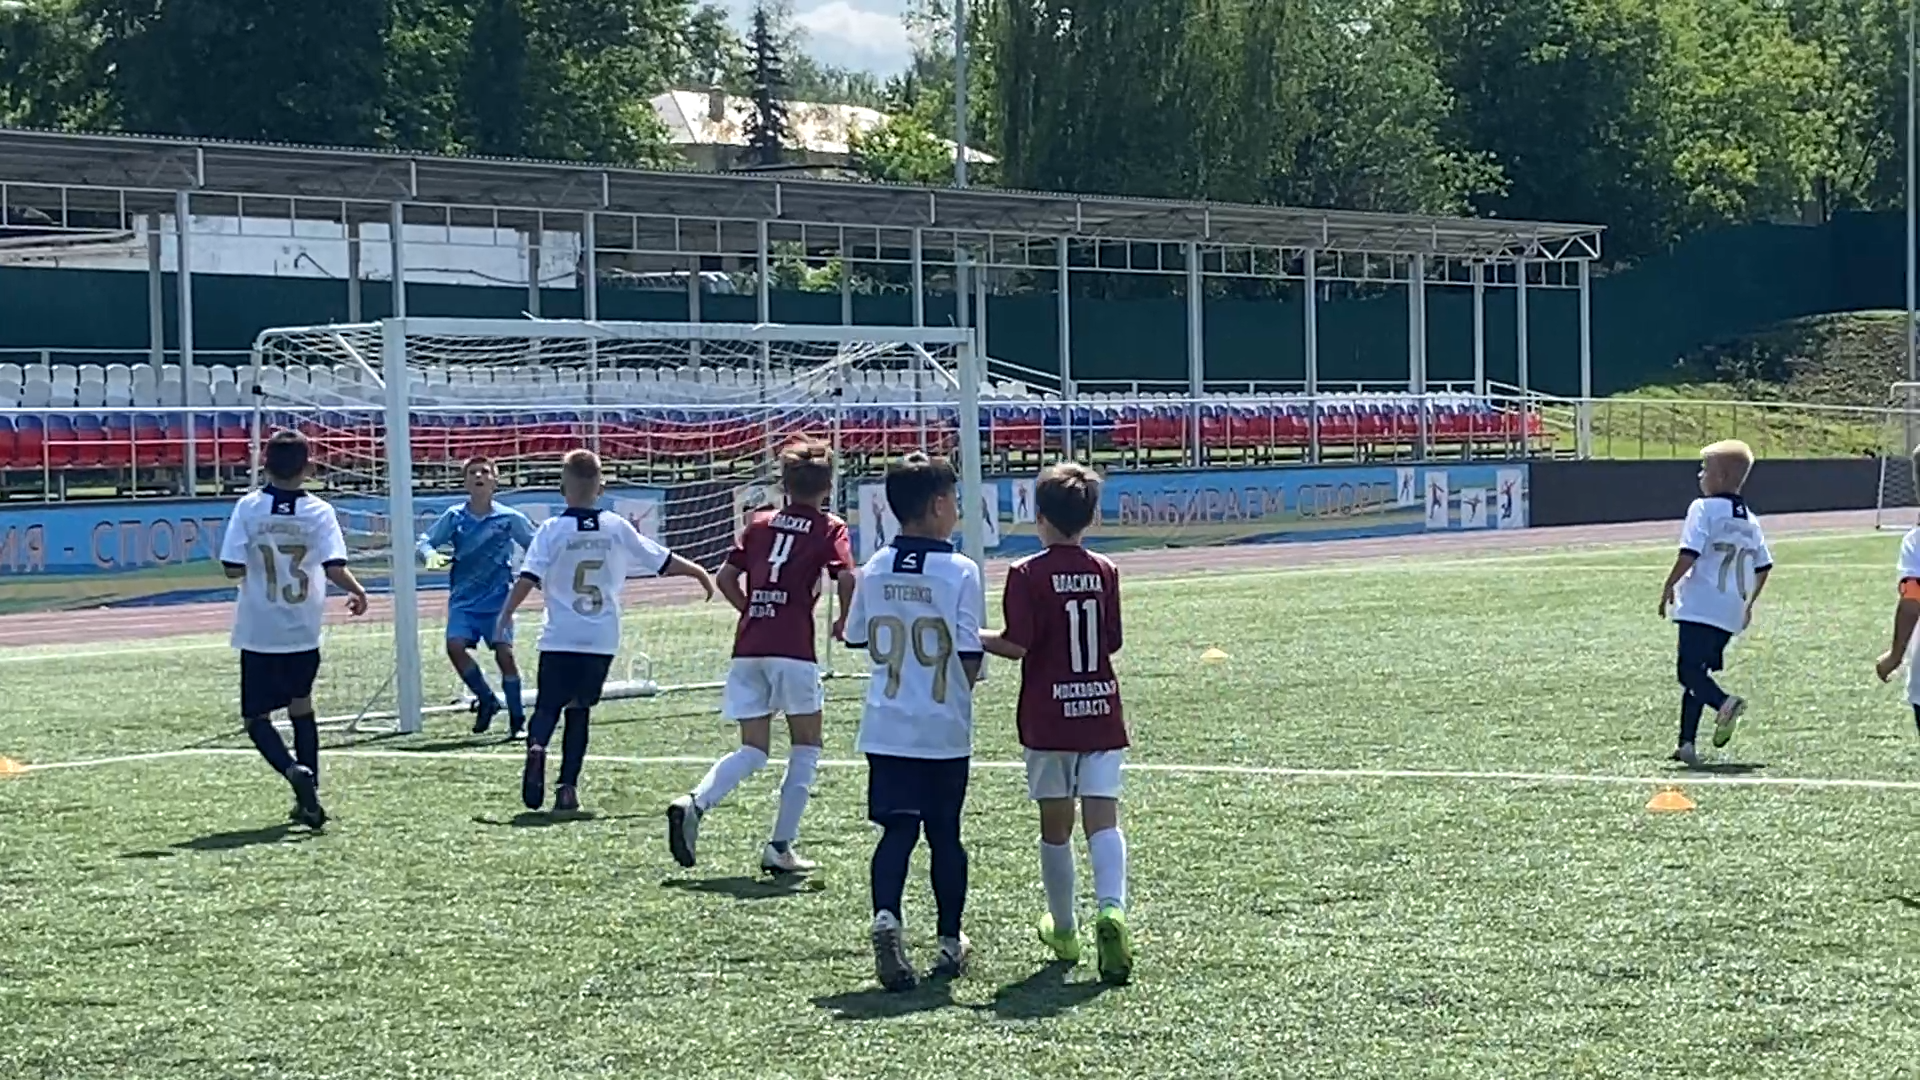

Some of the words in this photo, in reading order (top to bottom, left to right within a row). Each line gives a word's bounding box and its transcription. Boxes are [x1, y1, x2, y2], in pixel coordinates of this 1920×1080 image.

[1119, 486, 1286, 526] ВЫБИРАЕМ
[1297, 482, 1392, 520] СПОРТ
[258, 544, 309, 604] 13
[768, 533, 795, 583] 4
[1052, 574, 1102, 593] ВЛАСИХА
[1712, 541, 1758, 601] 70
[572, 560, 604, 617] 5
[868, 615, 953, 704] 99
[1065, 598, 1098, 673] 11
[1063, 699, 1111, 718] ОБЛАСТЬ
